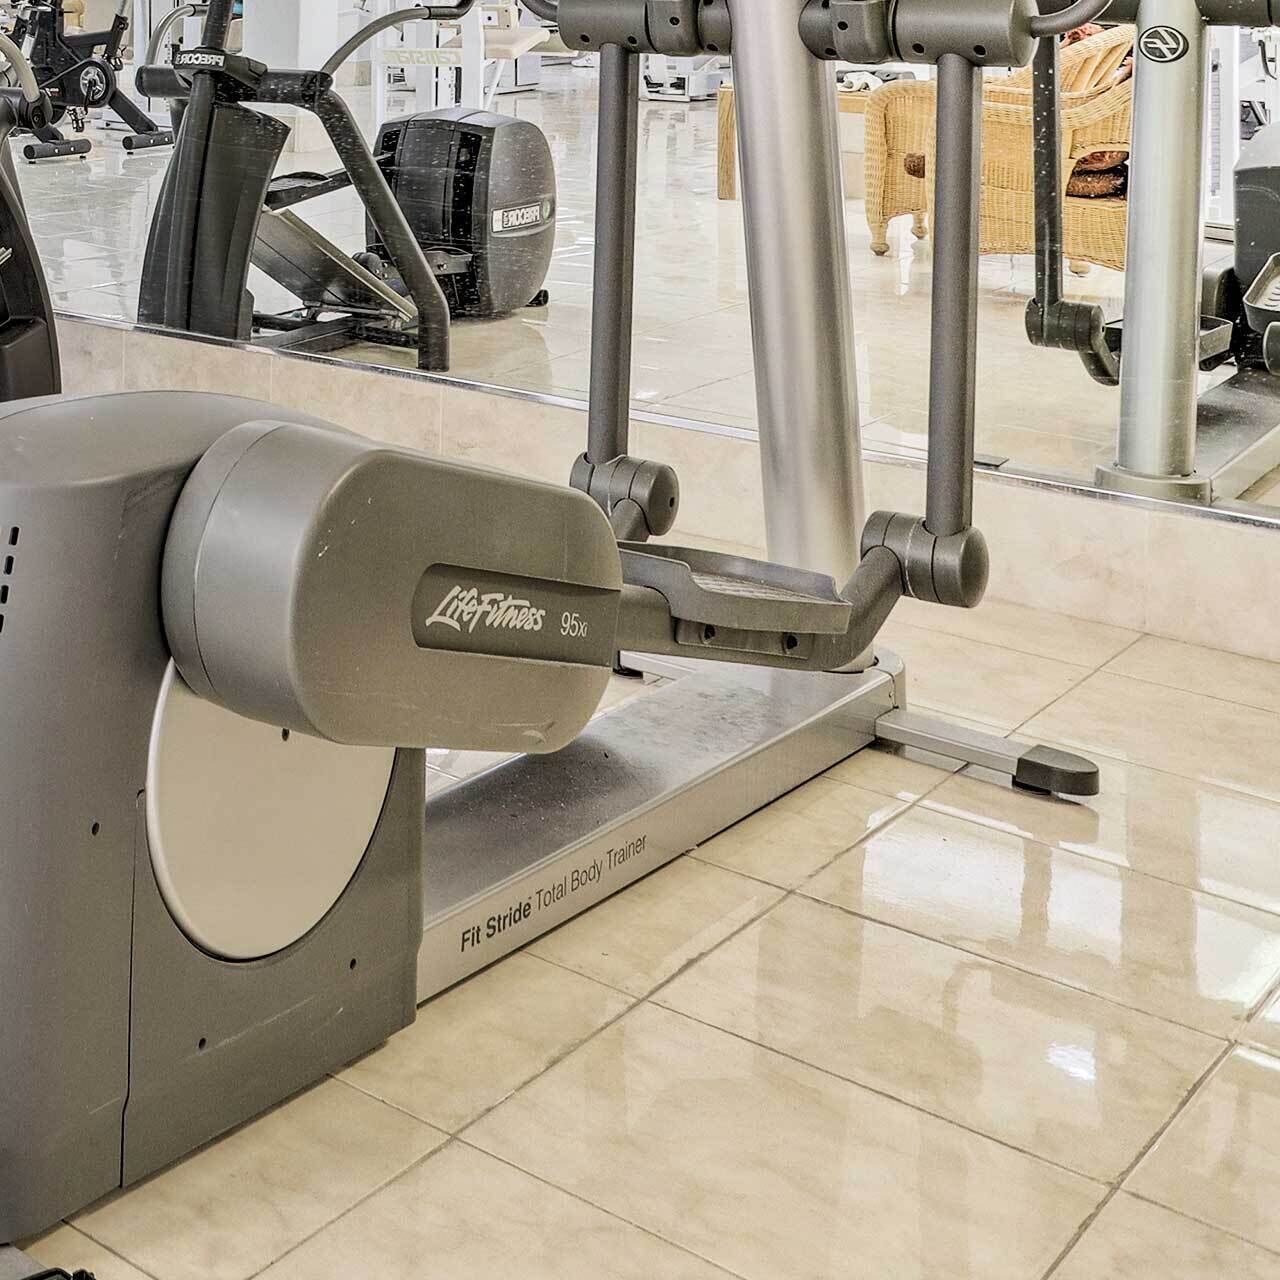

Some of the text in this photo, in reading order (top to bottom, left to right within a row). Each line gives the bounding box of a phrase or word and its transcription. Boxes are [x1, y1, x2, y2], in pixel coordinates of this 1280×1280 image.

[460, 834, 648, 952] Fit Stride Total Body Trainer
